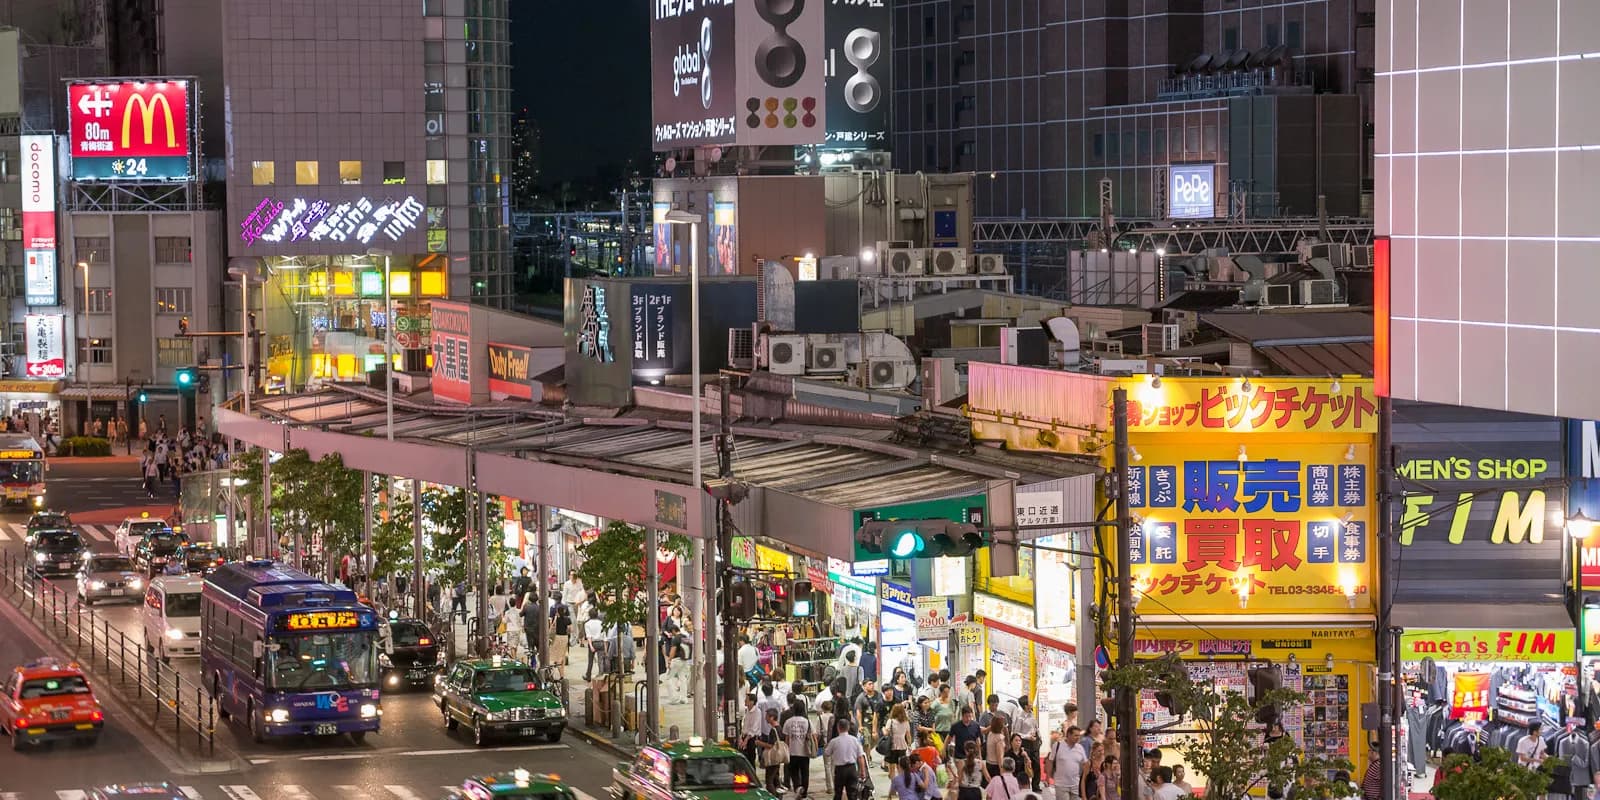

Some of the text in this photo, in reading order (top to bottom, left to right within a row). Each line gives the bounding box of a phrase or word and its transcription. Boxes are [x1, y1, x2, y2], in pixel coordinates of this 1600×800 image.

[673, 41, 700, 96] global
[85, 122, 109, 140] 80m
[30, 142, 42, 203] docomo
[126, 158, 147, 175] 24
[1174, 174, 1209, 202] PePe
[632, 295, 644, 305] 3F
[433, 335, 469, 383] 大黒屋
[489, 346, 508, 380] Duty
[1201, 386, 1375, 429] ビックチケット
[1183, 458, 1301, 513] 販売
[1311, 465, 1329, 504] 商品券
[1343, 466, 1361, 504] 株主券
[1396, 457, 1547, 480] MEN'S SHOP
[1016, 505, 1059, 516] 東口近道
[1399, 490, 1546, 546] FIM
[1183, 518, 1302, 572] 買取
[1313, 525, 1329, 559] 切手
[1343, 522, 1361, 561] 食事券
[918, 617, 945, 628] 2900
[1311, 630, 1355, 638] NARITAYA
[1413, 631, 1556, 654] men's FIM
[1453, 689, 1488, 708] SALE
